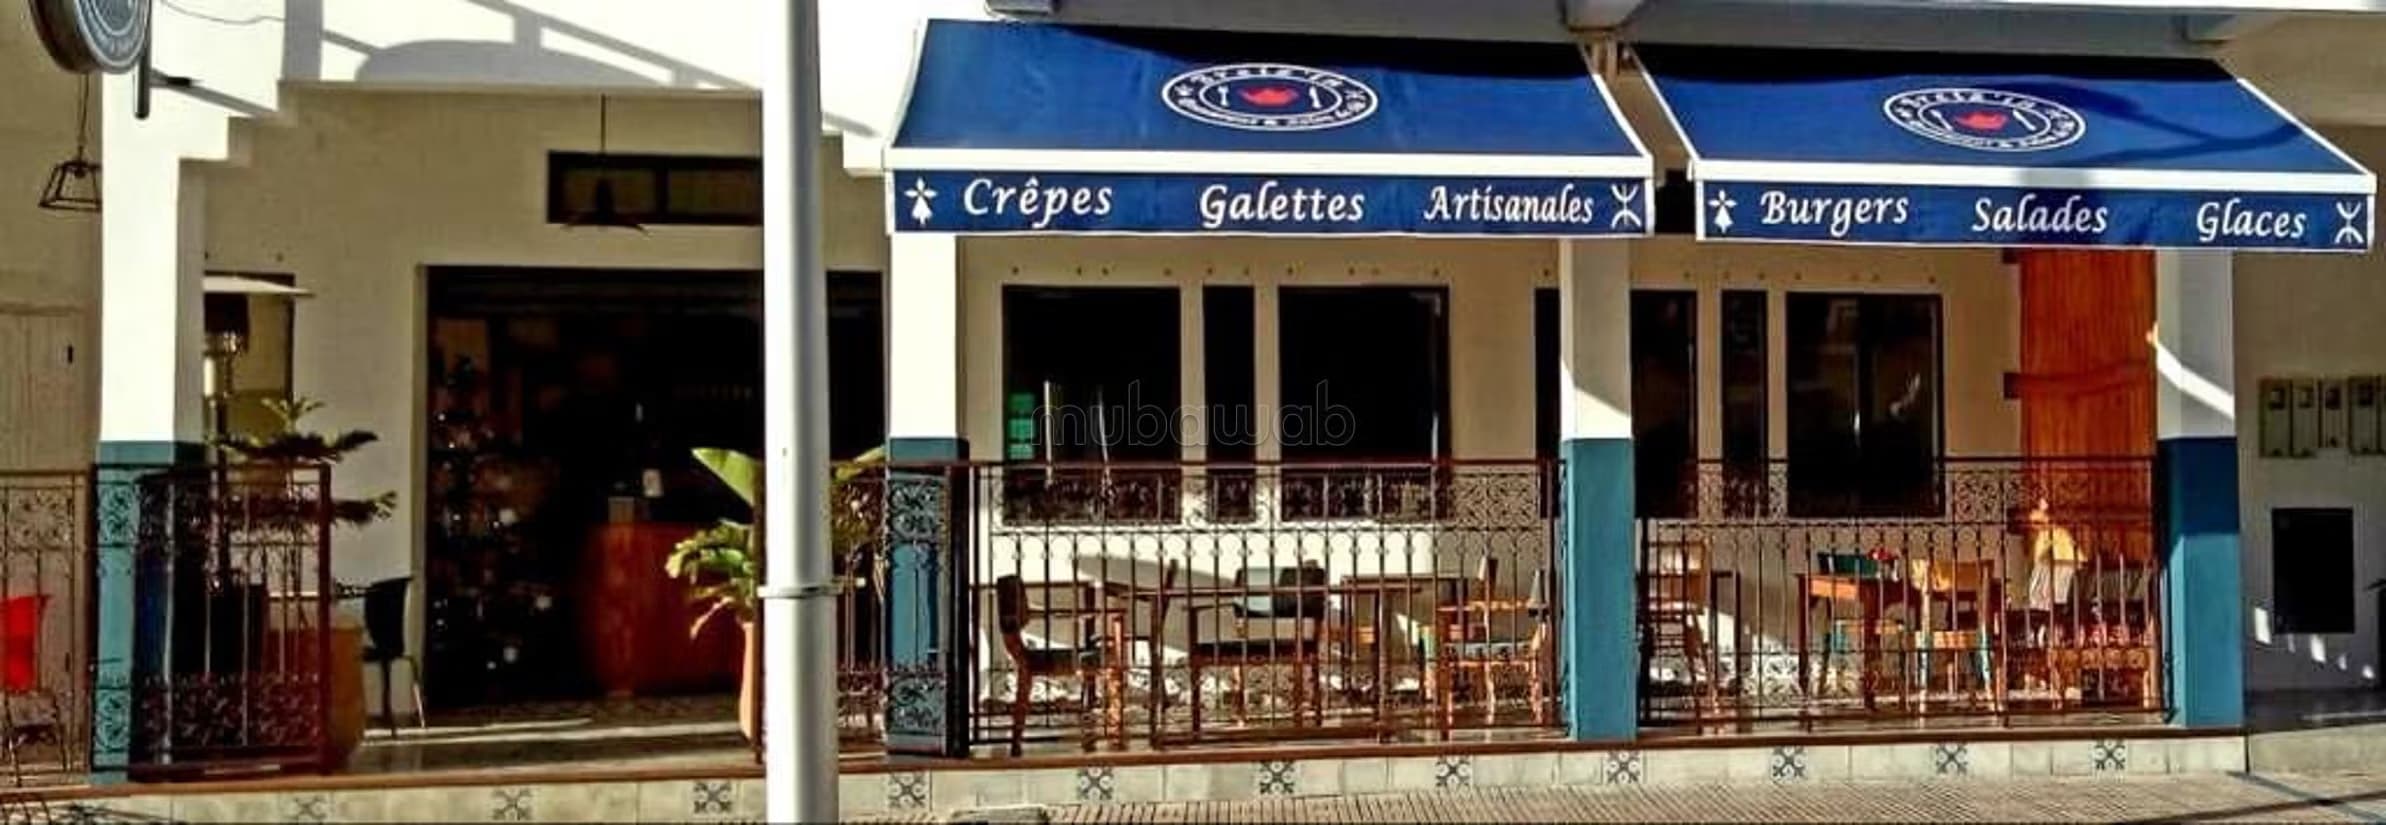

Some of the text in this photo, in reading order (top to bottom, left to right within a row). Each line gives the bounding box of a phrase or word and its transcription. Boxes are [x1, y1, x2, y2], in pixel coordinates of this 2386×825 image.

[963, 178, 1594, 229] Crêpes Galettes Artisanales
[1760, 190, 2307, 243] Burgers Salades Glaces
